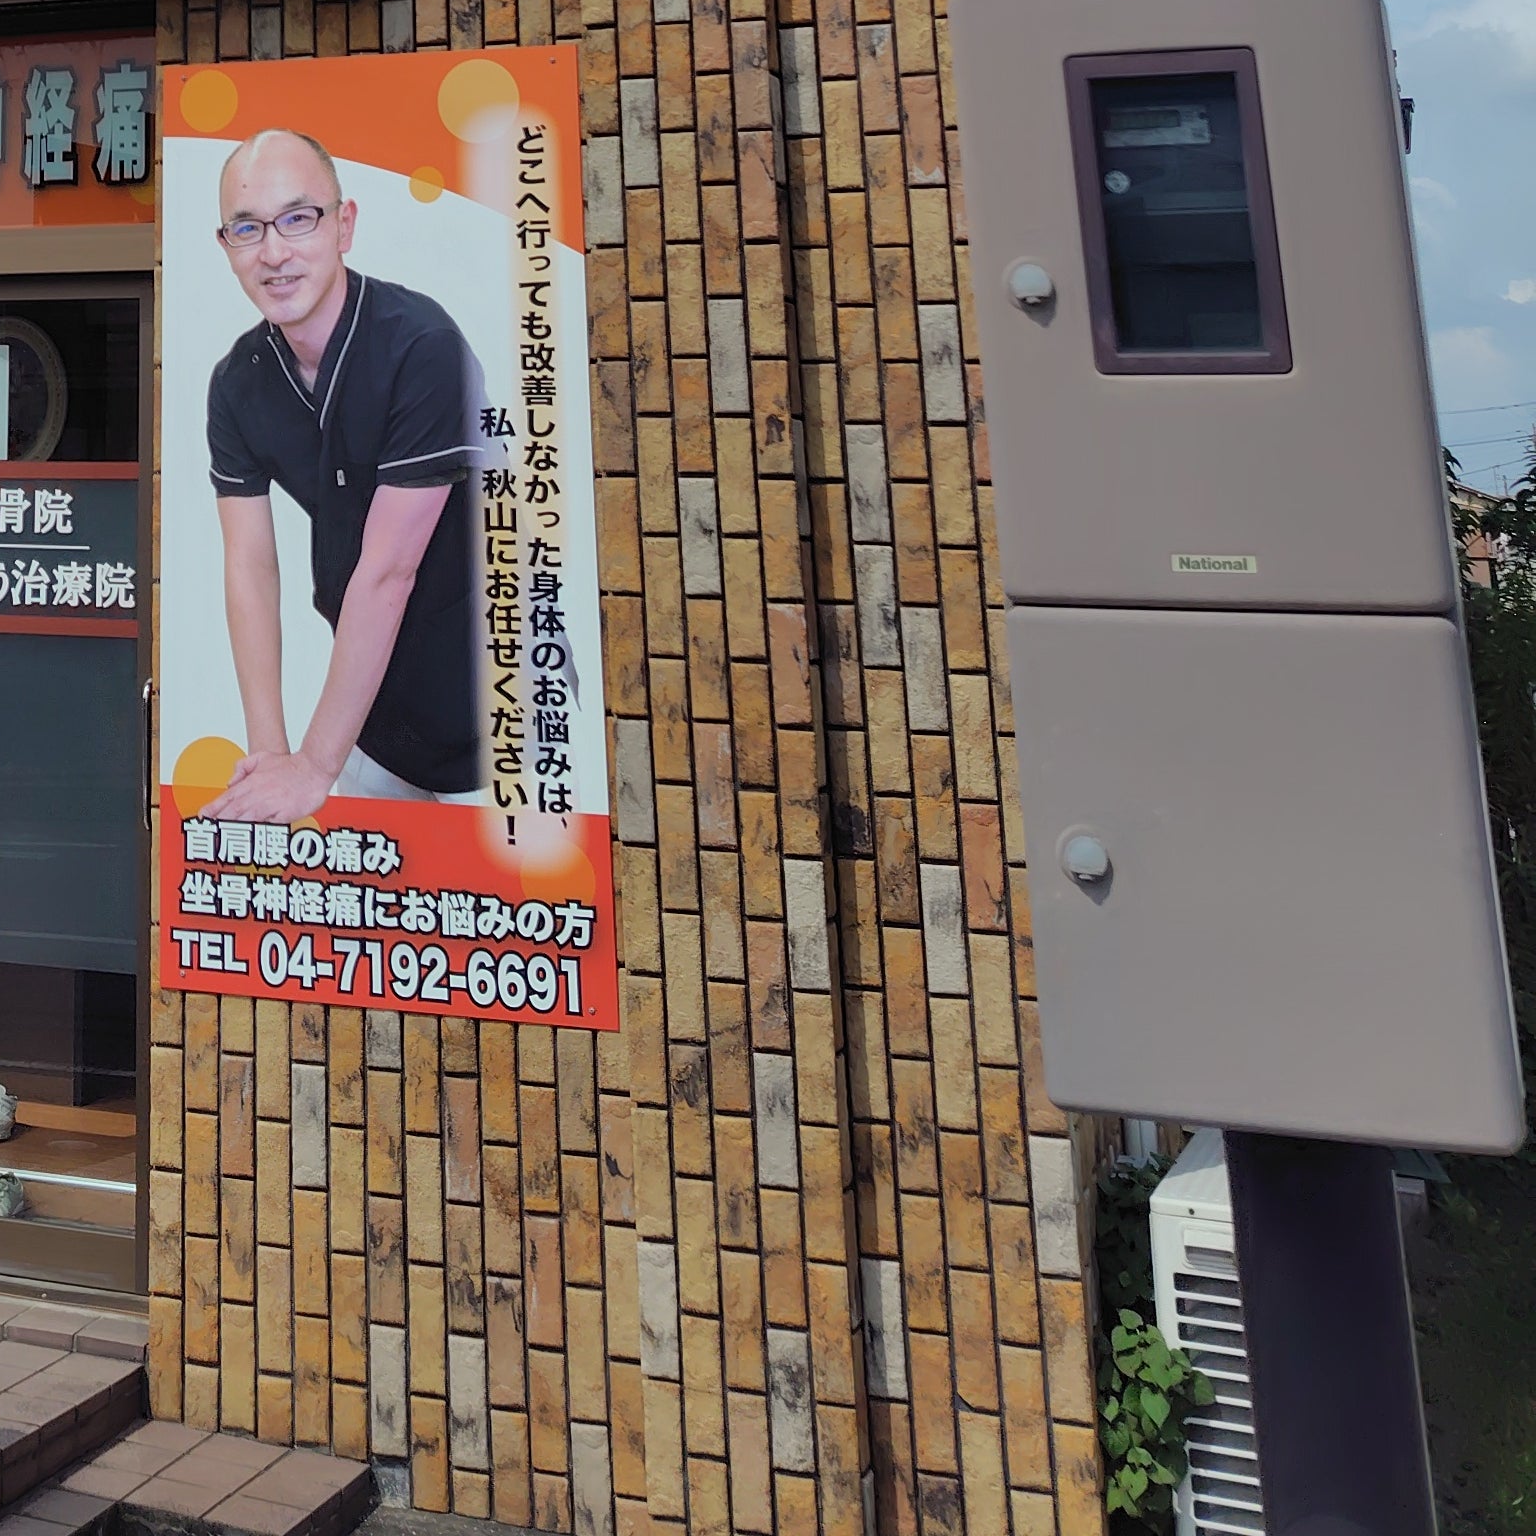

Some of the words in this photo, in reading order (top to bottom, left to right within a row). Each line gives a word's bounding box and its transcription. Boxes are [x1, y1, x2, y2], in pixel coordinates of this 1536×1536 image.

[515, 124, 574, 830] どこへ行っても改善しなかった身体のお悩みは、
[1178, 557, 1248, 571] National
[183, 819, 401, 875] 首肩腰の痛み
[181, 872, 595, 947] 坐骨神経痛にお悩みの方
[172, 930, 248, 973] TEL
[260, 930, 582, 1014] 04-7192-6691
